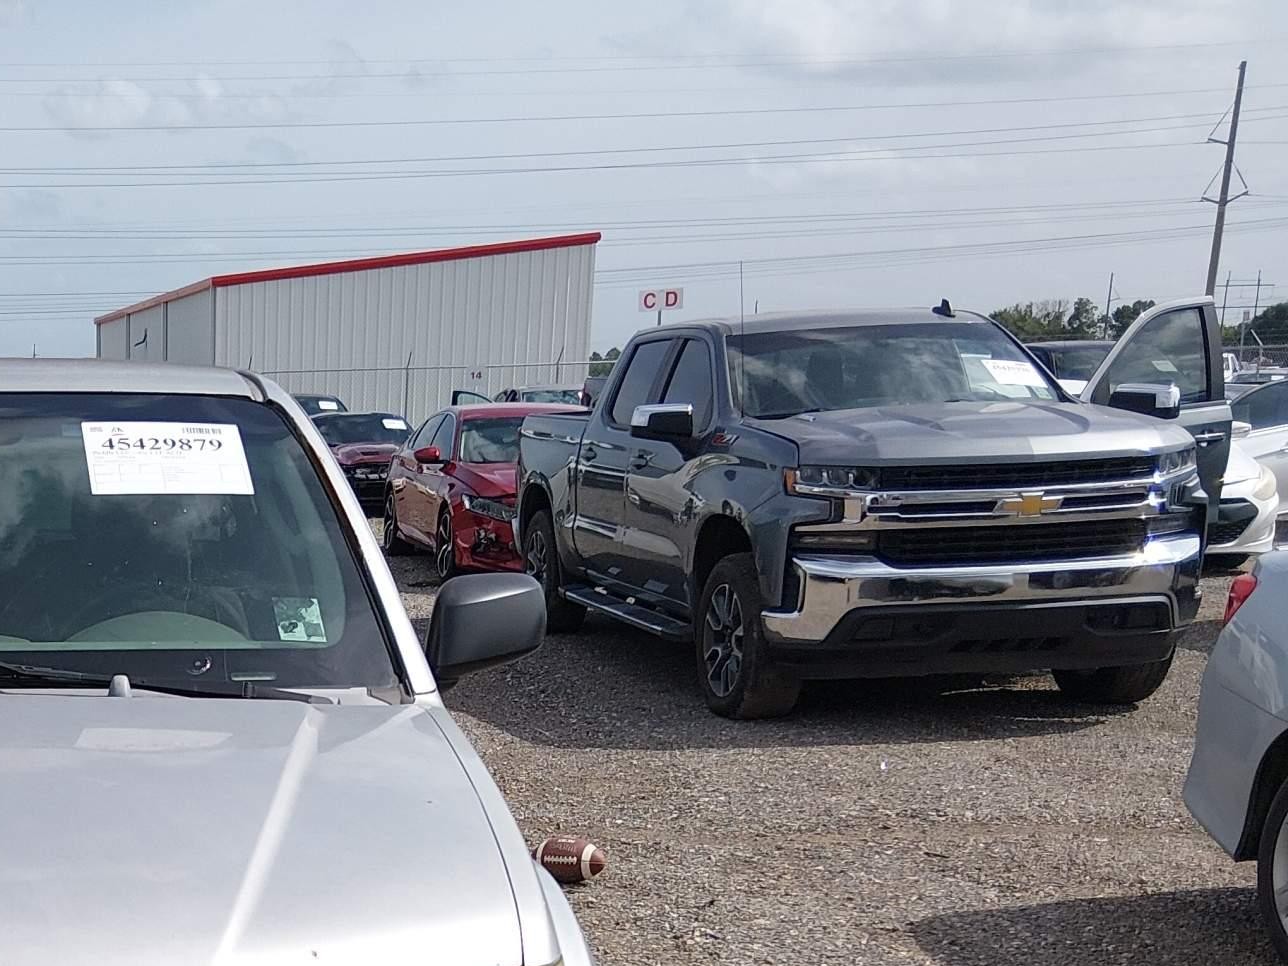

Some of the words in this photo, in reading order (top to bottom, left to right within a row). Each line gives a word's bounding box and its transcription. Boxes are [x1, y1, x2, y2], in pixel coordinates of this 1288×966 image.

[643, 292, 657, 309] C
[665, 291, 678, 307] D
[470, 371, 483, 380] 14
[101, 437, 223, 452] 45429879
